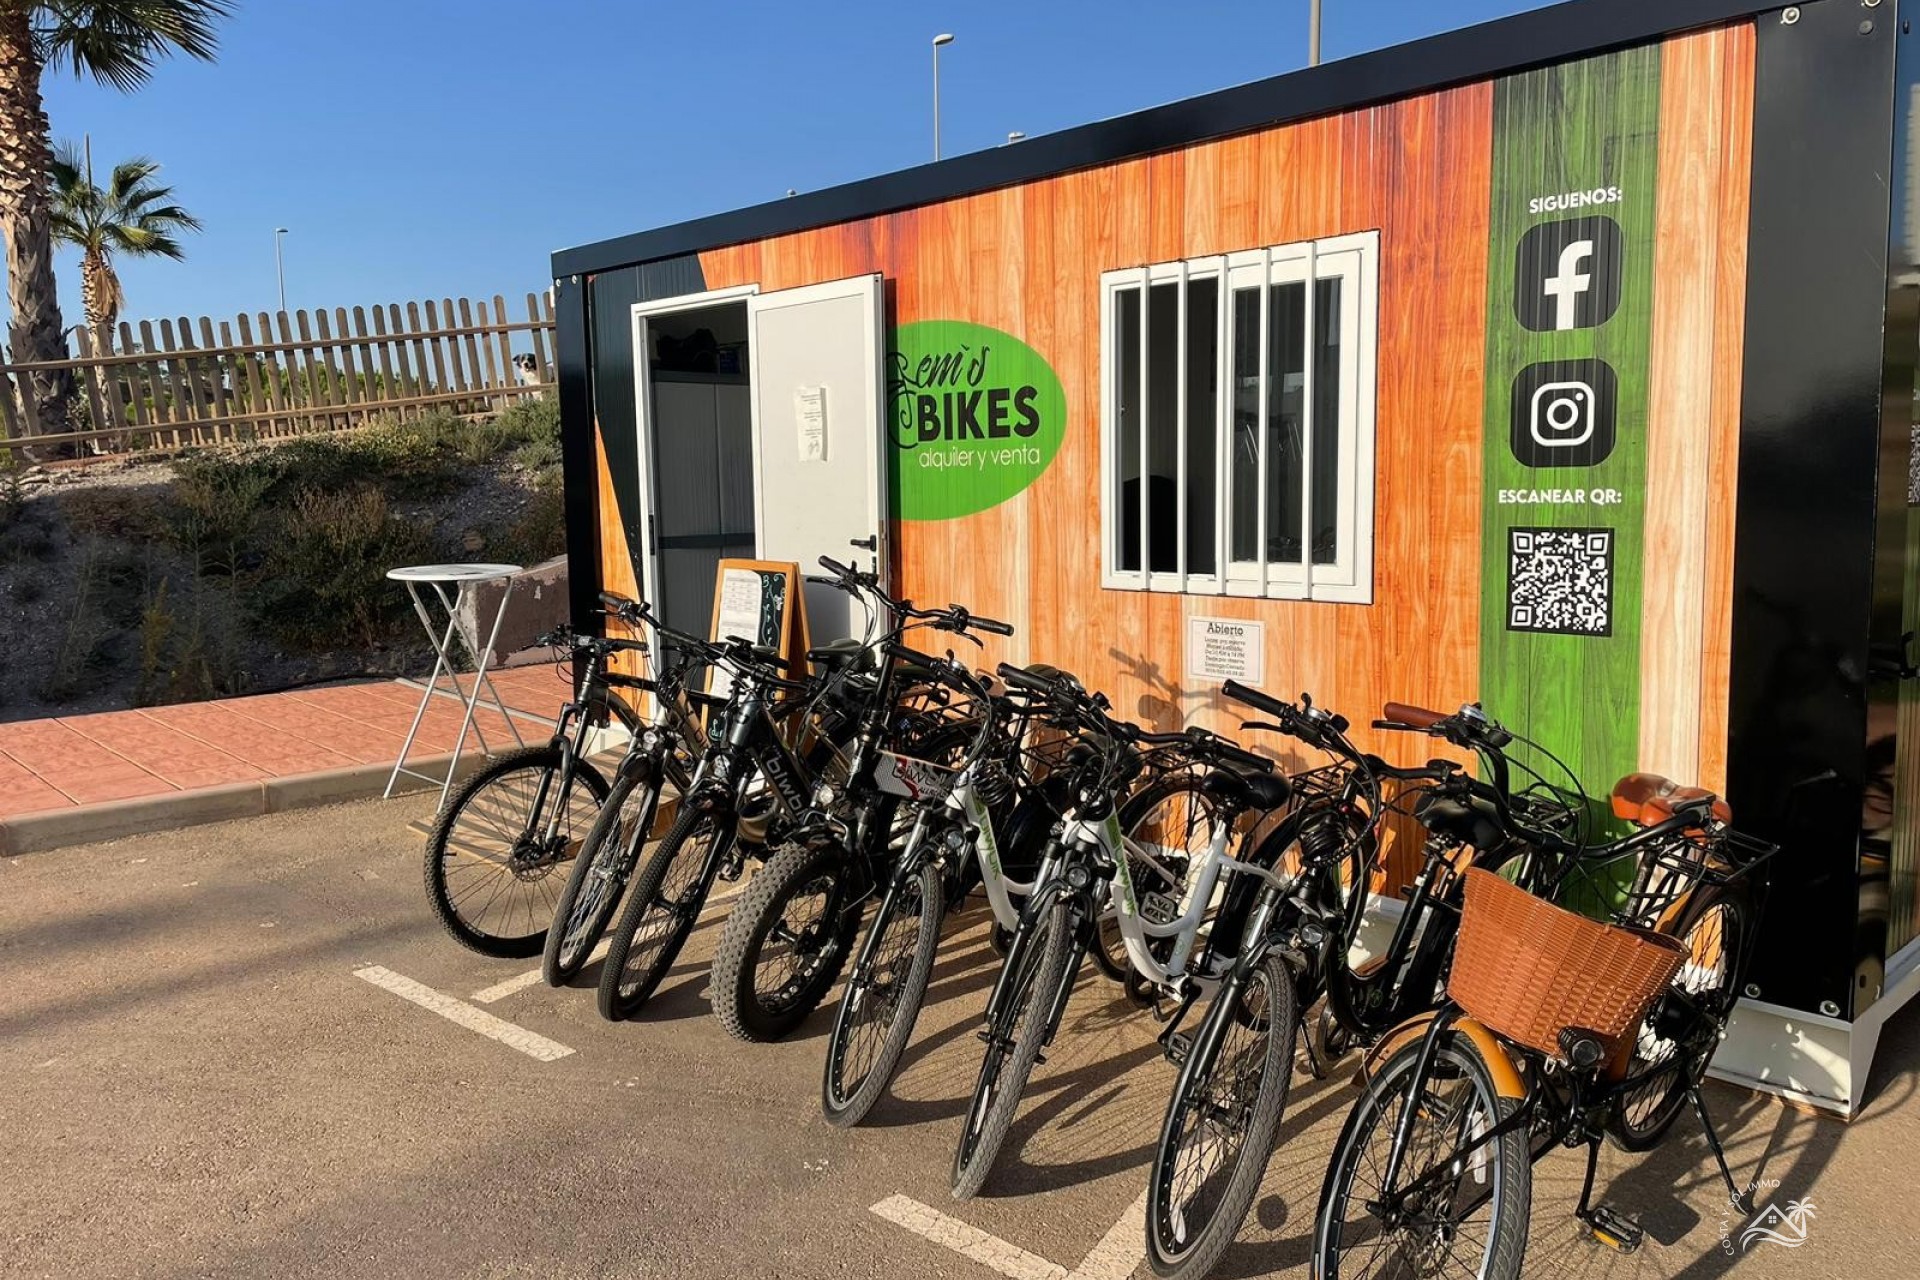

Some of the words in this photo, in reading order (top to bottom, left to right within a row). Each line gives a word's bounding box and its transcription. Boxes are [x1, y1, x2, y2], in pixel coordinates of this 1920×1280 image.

[1529, 186, 1622, 213] SIGUENOS:
[916, 386, 1040, 442] BIKES
[919, 446, 974, 472] alquiler
[977, 450, 987, 471] y
[990, 443, 1040, 465] venta
[1498, 489, 1586, 504] ESCANEAR
[1590, 488, 1622, 506] QR:
[1206, 622, 1244, 635] Abierto
